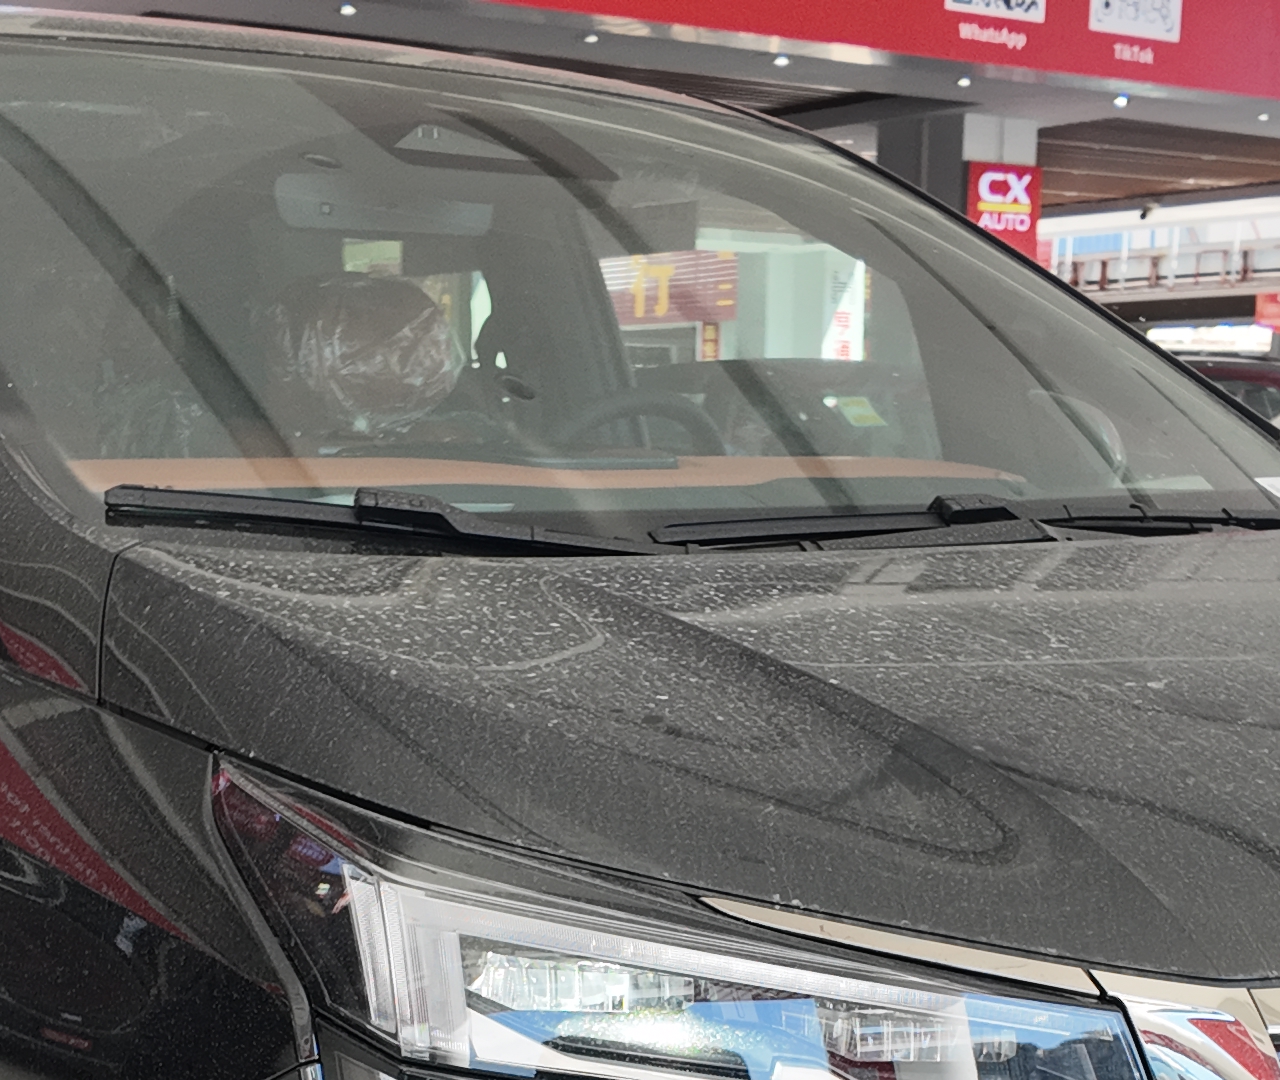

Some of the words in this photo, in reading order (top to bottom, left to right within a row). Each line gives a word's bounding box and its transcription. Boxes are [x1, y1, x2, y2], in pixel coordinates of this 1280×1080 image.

[959, 22, 1027, 50] WhatsApp
[1113, 42, 1154, 64] TikTok
[977, 171, 1032, 205] CX
[977, 211, 1032, 233] AUTO
